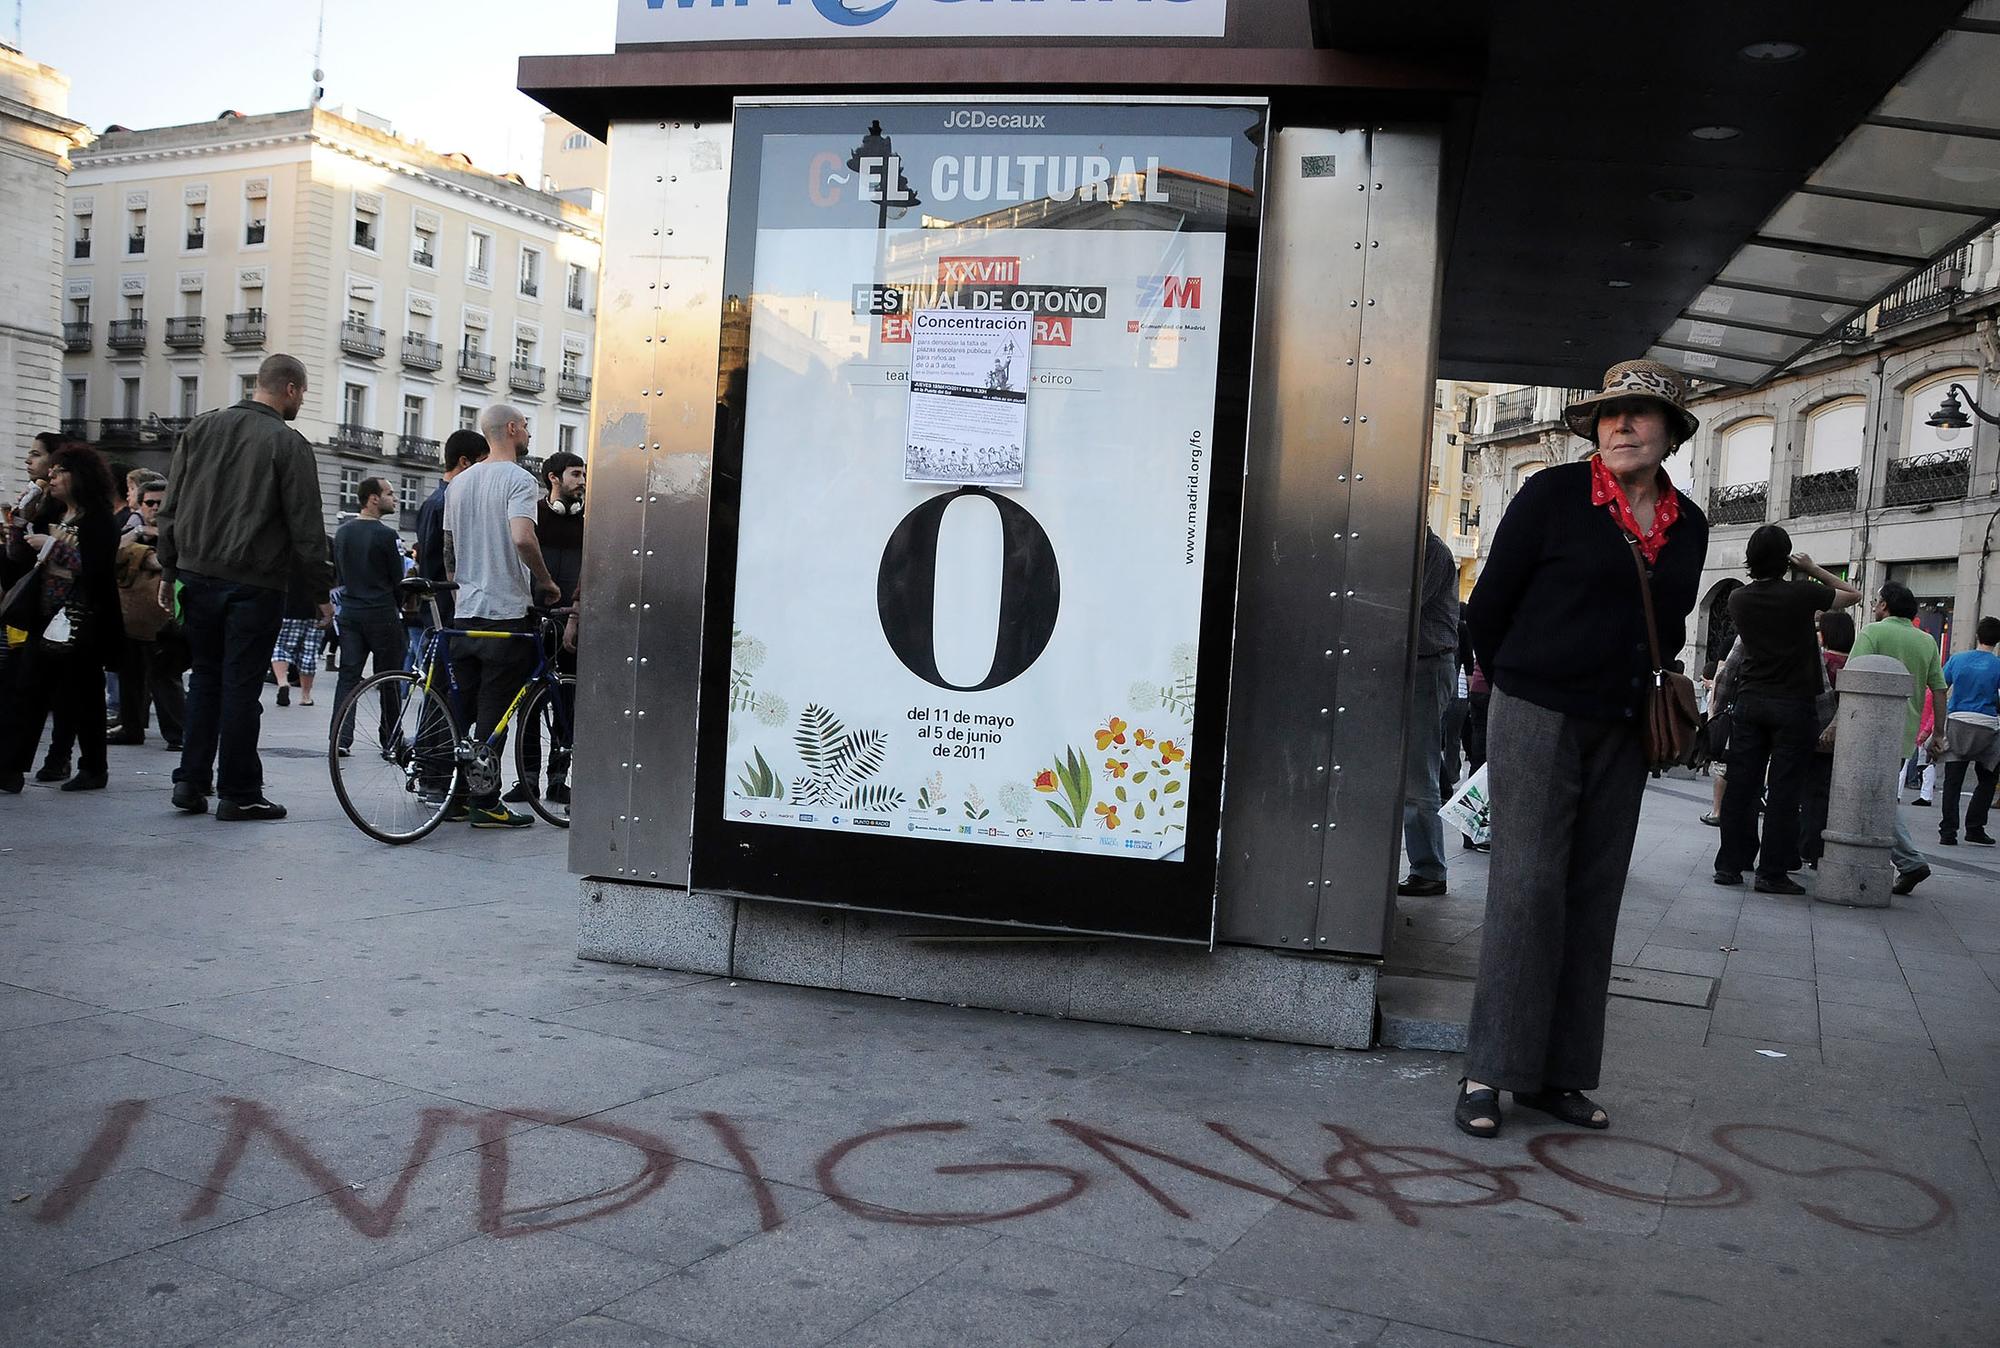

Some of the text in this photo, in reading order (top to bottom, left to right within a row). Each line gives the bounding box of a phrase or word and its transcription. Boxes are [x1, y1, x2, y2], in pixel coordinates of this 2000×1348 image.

[943, 110, 1047, 129] JCDecaux
[858, 156, 910, 202] EL
[930, 155, 1170, 203] CULTURAL
[942, 261, 1014, 282] XXVIII
[856, 288, 1103, 313] FESTIVAL DE OTOÑO
[886, 319, 912, 338] EN
[917, 315, 1027, 330] Concentración
[917, 346, 936, 354] plazas
[937, 346, 966, 354] escolares
[932, 339, 959, 347] denunciar
[886, 371, 1073, 385] teat circo
[1186, 430, 1202, 564] www.madrid.org/fo
[907, 707, 1014, 729] del 11 de mayo
[917, 725, 1002, 744] al 5 de junio
[932, 744, 986, 759] de 2011
